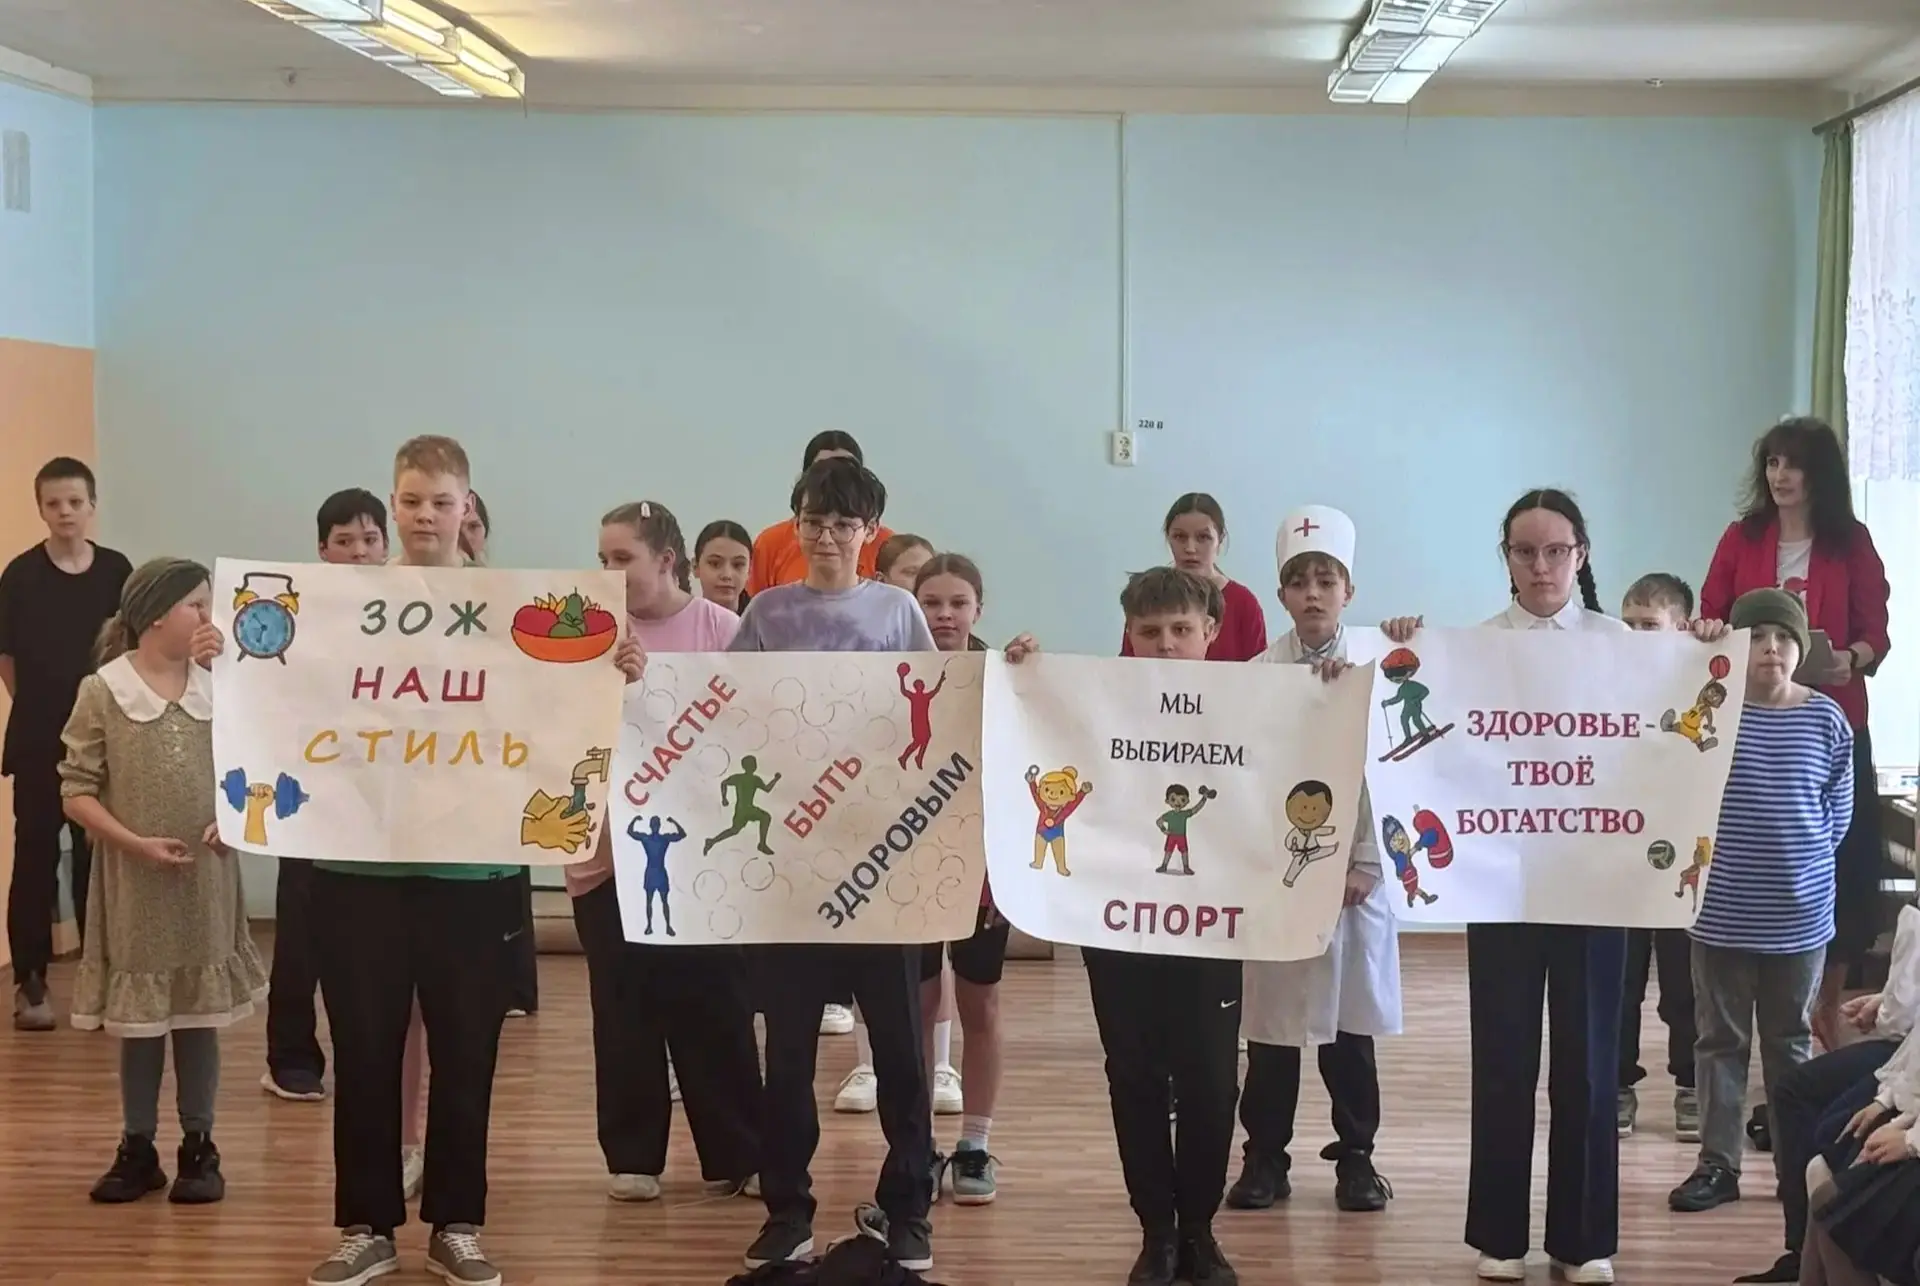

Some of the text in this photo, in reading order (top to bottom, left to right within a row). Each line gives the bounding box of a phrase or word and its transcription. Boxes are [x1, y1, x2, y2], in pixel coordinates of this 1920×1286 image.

[1138, 419, 1155, 429] 220
[359, 598, 489, 638] ЗОЖ
[351, 665, 487, 703] НАШ
[1159, 692, 1204, 716] МЫ
[303, 728, 530, 769] СТИЛЬ
[623, 674, 738, 807] СЧАСТЬЕ
[1109, 737, 1245, 767] ВЫБИРАЕМ
[1506, 754, 1596, 787] ТВОЁ
[783, 754, 863, 839] БЫТЬ
[817, 751, 975, 930] ЗДОРОВЫМ
[1456, 807, 1646, 837] БОГАТСТВО
[1103, 899, 1245, 940] СПОРТ
